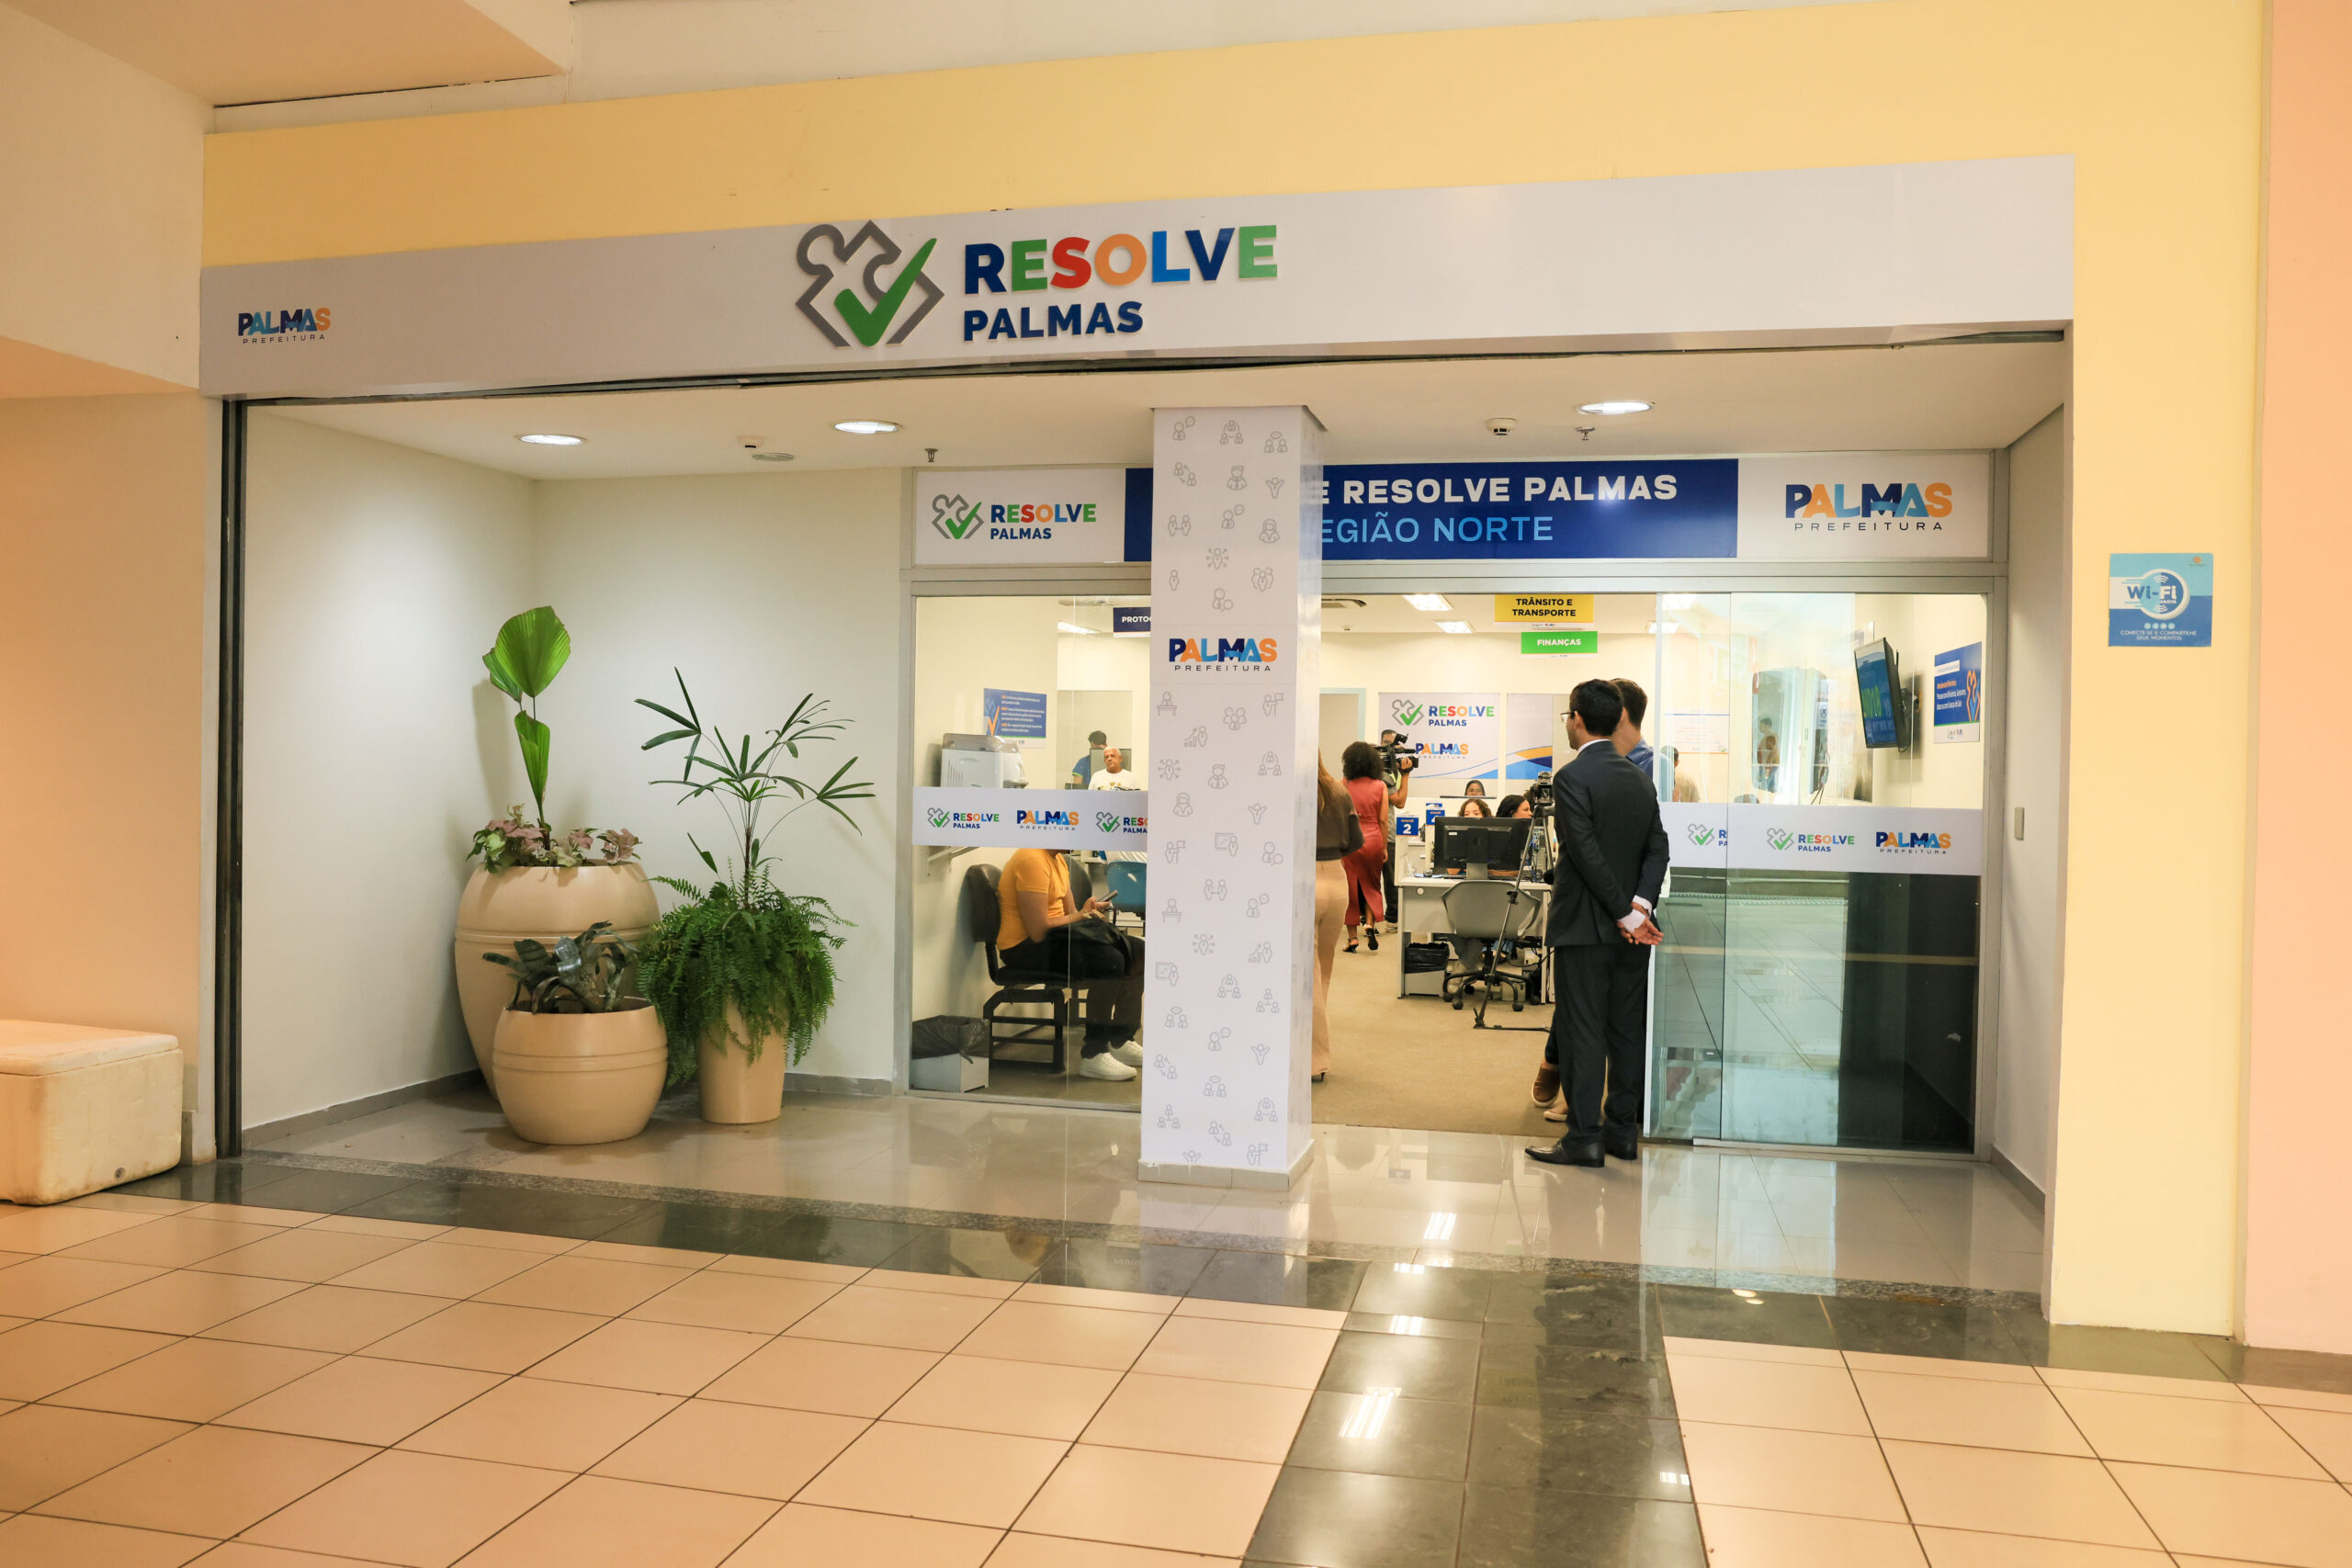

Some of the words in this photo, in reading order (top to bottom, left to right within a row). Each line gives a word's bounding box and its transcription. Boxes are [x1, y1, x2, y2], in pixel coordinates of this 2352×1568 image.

[965, 224, 1278, 295] RESOLVE
[238, 307, 331, 336] PALMAS
[964, 300, 1143, 342] PALMAS
[243, 333, 325, 344] PREFEITURA
[1343, 478, 1510, 504] RESOLVE
[1524, 474, 1678, 502] PALMAS
[1785, 482, 1953, 519] PALMAS
[990, 503, 1097, 524] RESOLVE
[990, 527, 1052, 540] PALMAS
[1433, 515, 1554, 543] NORTE
[1794, 522, 1943, 531] PREFEITURA
[2127, 585, 2177, 600] Wi-Fi
[1516, 597, 1565, 606] TRÂNSITO
[1169, 637, 1278, 662] PALMAS
[1536, 638, 1582, 647] FINANÇAS
[1429, 705, 1495, 716] RESOLVE
[1415, 742, 1469, 755] PALMAS
[953, 812, 1000, 822] RESOLVE
[1016, 810, 1080, 826] PALMAS
[1403, 823, 1412, 834] 2
[1798, 834, 1855, 845] RESOLVE
[1876, 831, 1951, 849] PALMAS
